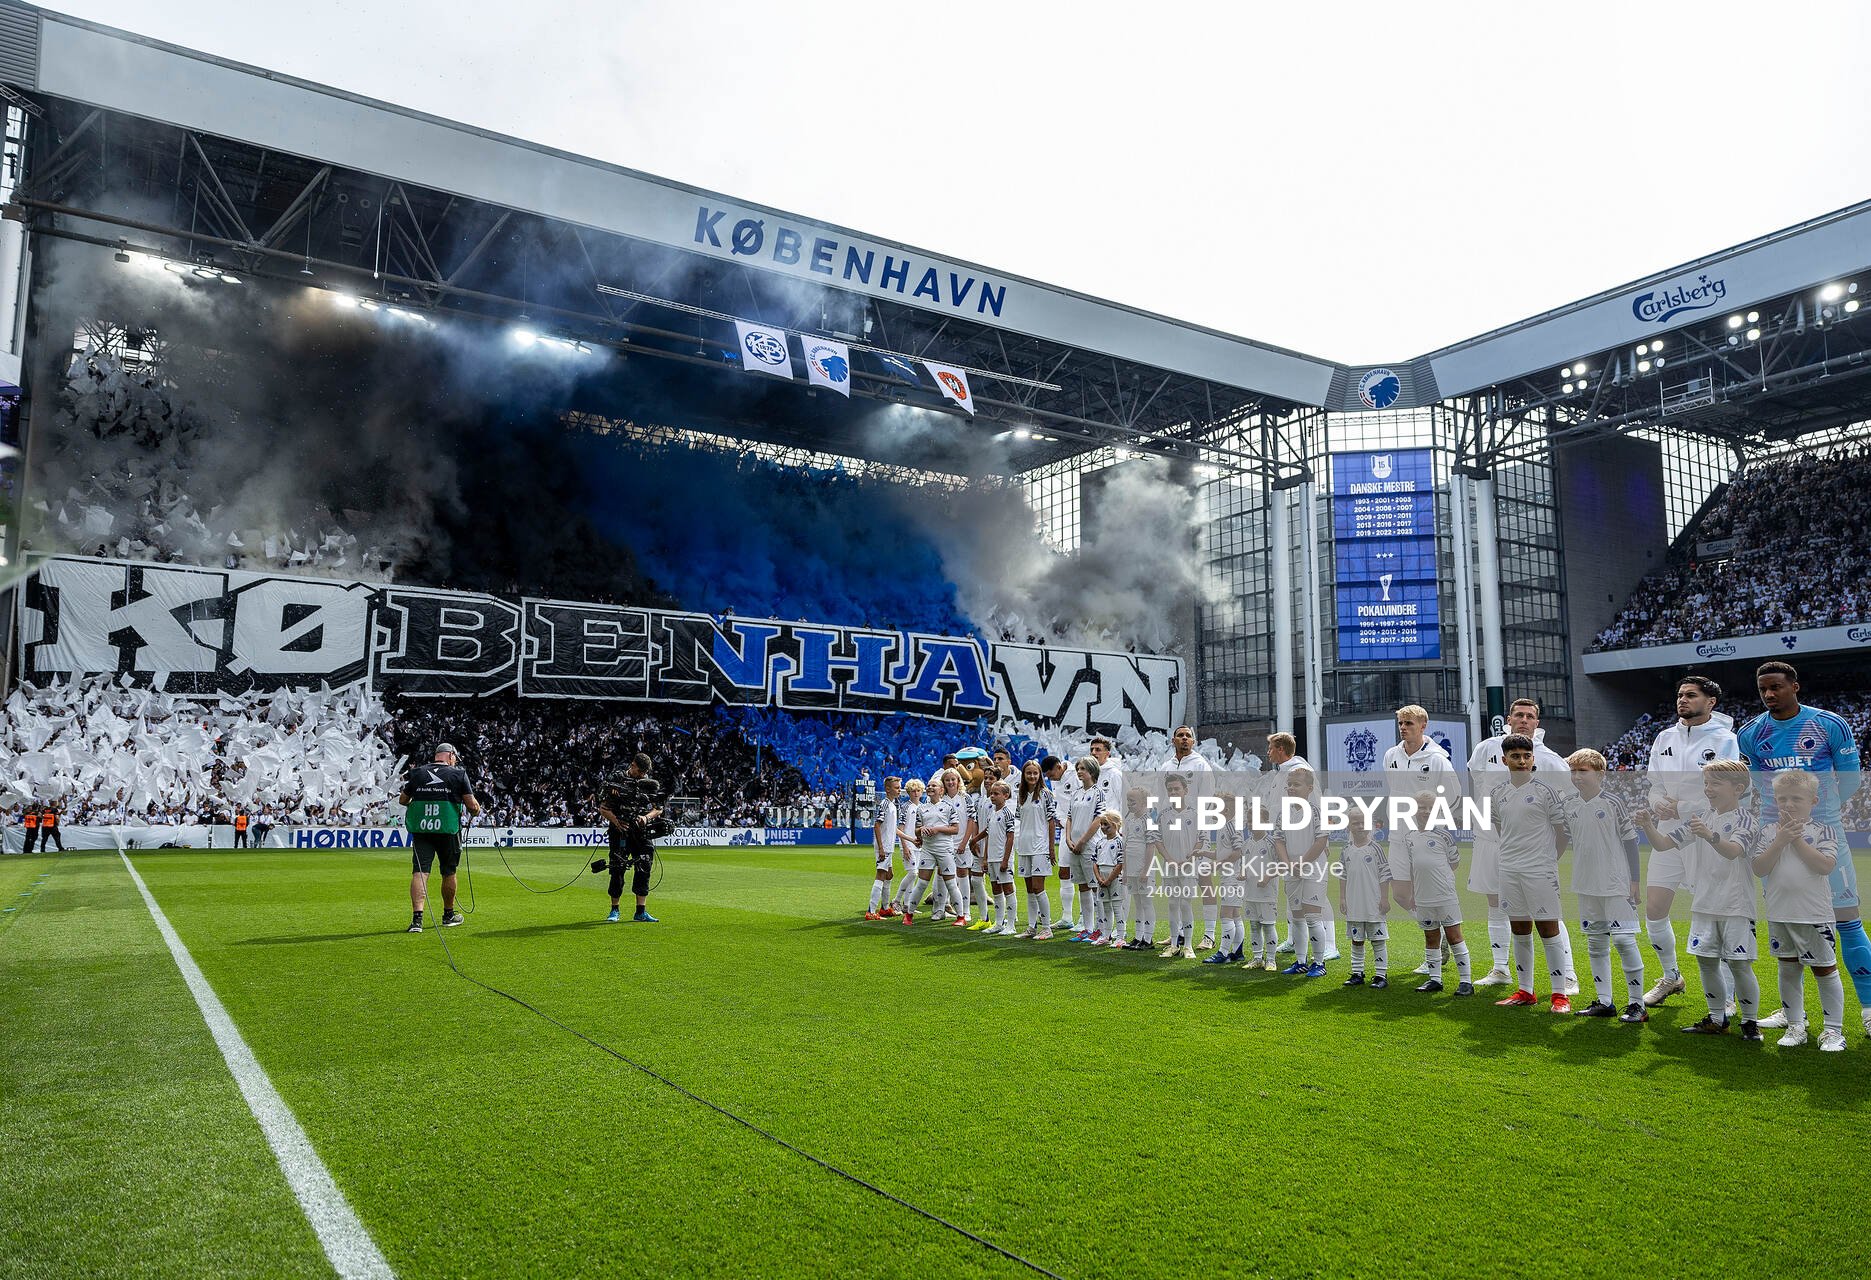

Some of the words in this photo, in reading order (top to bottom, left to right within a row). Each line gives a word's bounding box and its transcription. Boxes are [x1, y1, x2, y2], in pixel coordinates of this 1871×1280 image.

[695, 206, 1007, 318] KØBENHAVN
[1632, 274, 1727, 323] Carlsberg
[1350, 482, 1383, 495] DANSKE
[1383, 481, 1415, 493] MESTRE
[1358, 604, 1417, 617] POKALVINDERE
[1847, 627, 1871, 643] Carls
[24, 557, 1187, 730] KØBENHAVN
[1696, 642, 1737, 658] Carlsberg
[1490, 715, 1506, 737] Carls
[1764, 755, 1814, 768] UNIBET
[424, 803, 440, 816] HB
[420, 818, 441, 830] 060
[566, 829, 610, 846] myba
[668, 828, 728, 838] ROLÆGNING
